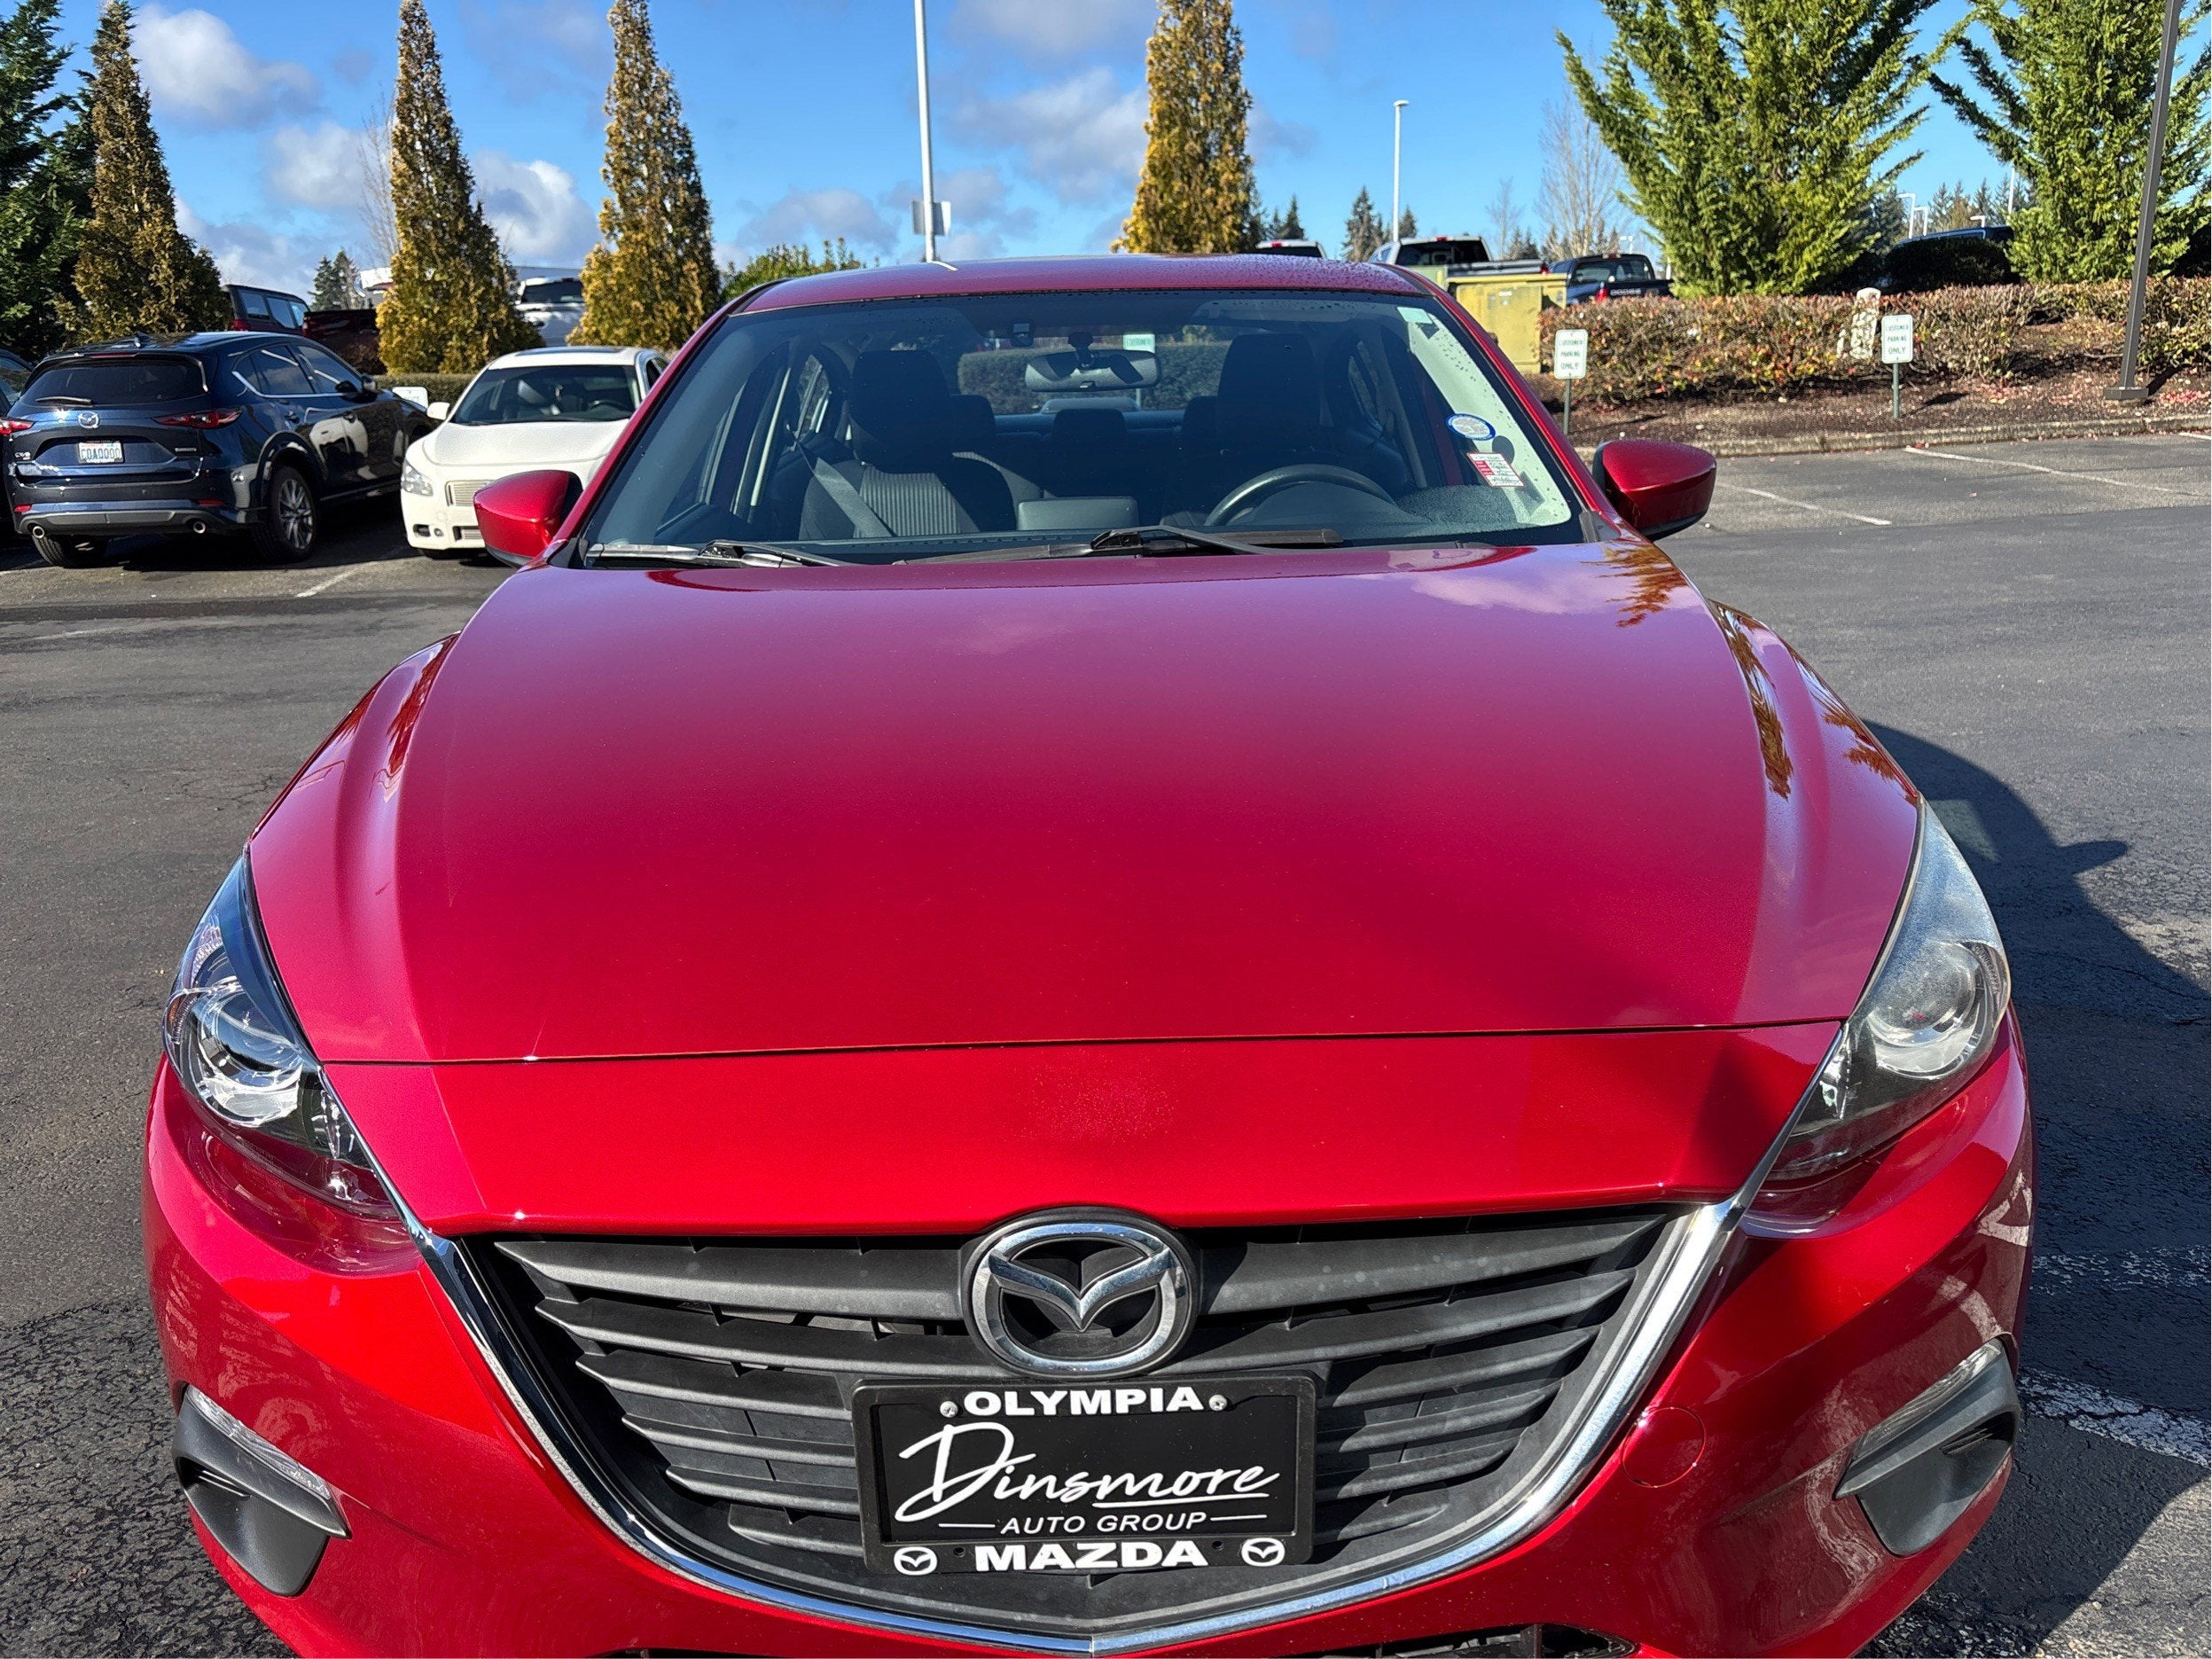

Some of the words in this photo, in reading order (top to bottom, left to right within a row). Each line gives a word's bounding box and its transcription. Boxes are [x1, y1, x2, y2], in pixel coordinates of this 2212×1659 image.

[964, 1386, 1205, 1417] OLYMPIA
[895, 1421, 1280, 1522] Dinsmore
[1000, 1517, 1086, 1534] AUTO
[1097, 1513, 1207, 1532] GROUP
[975, 1539, 1209, 1572] MAZDA
